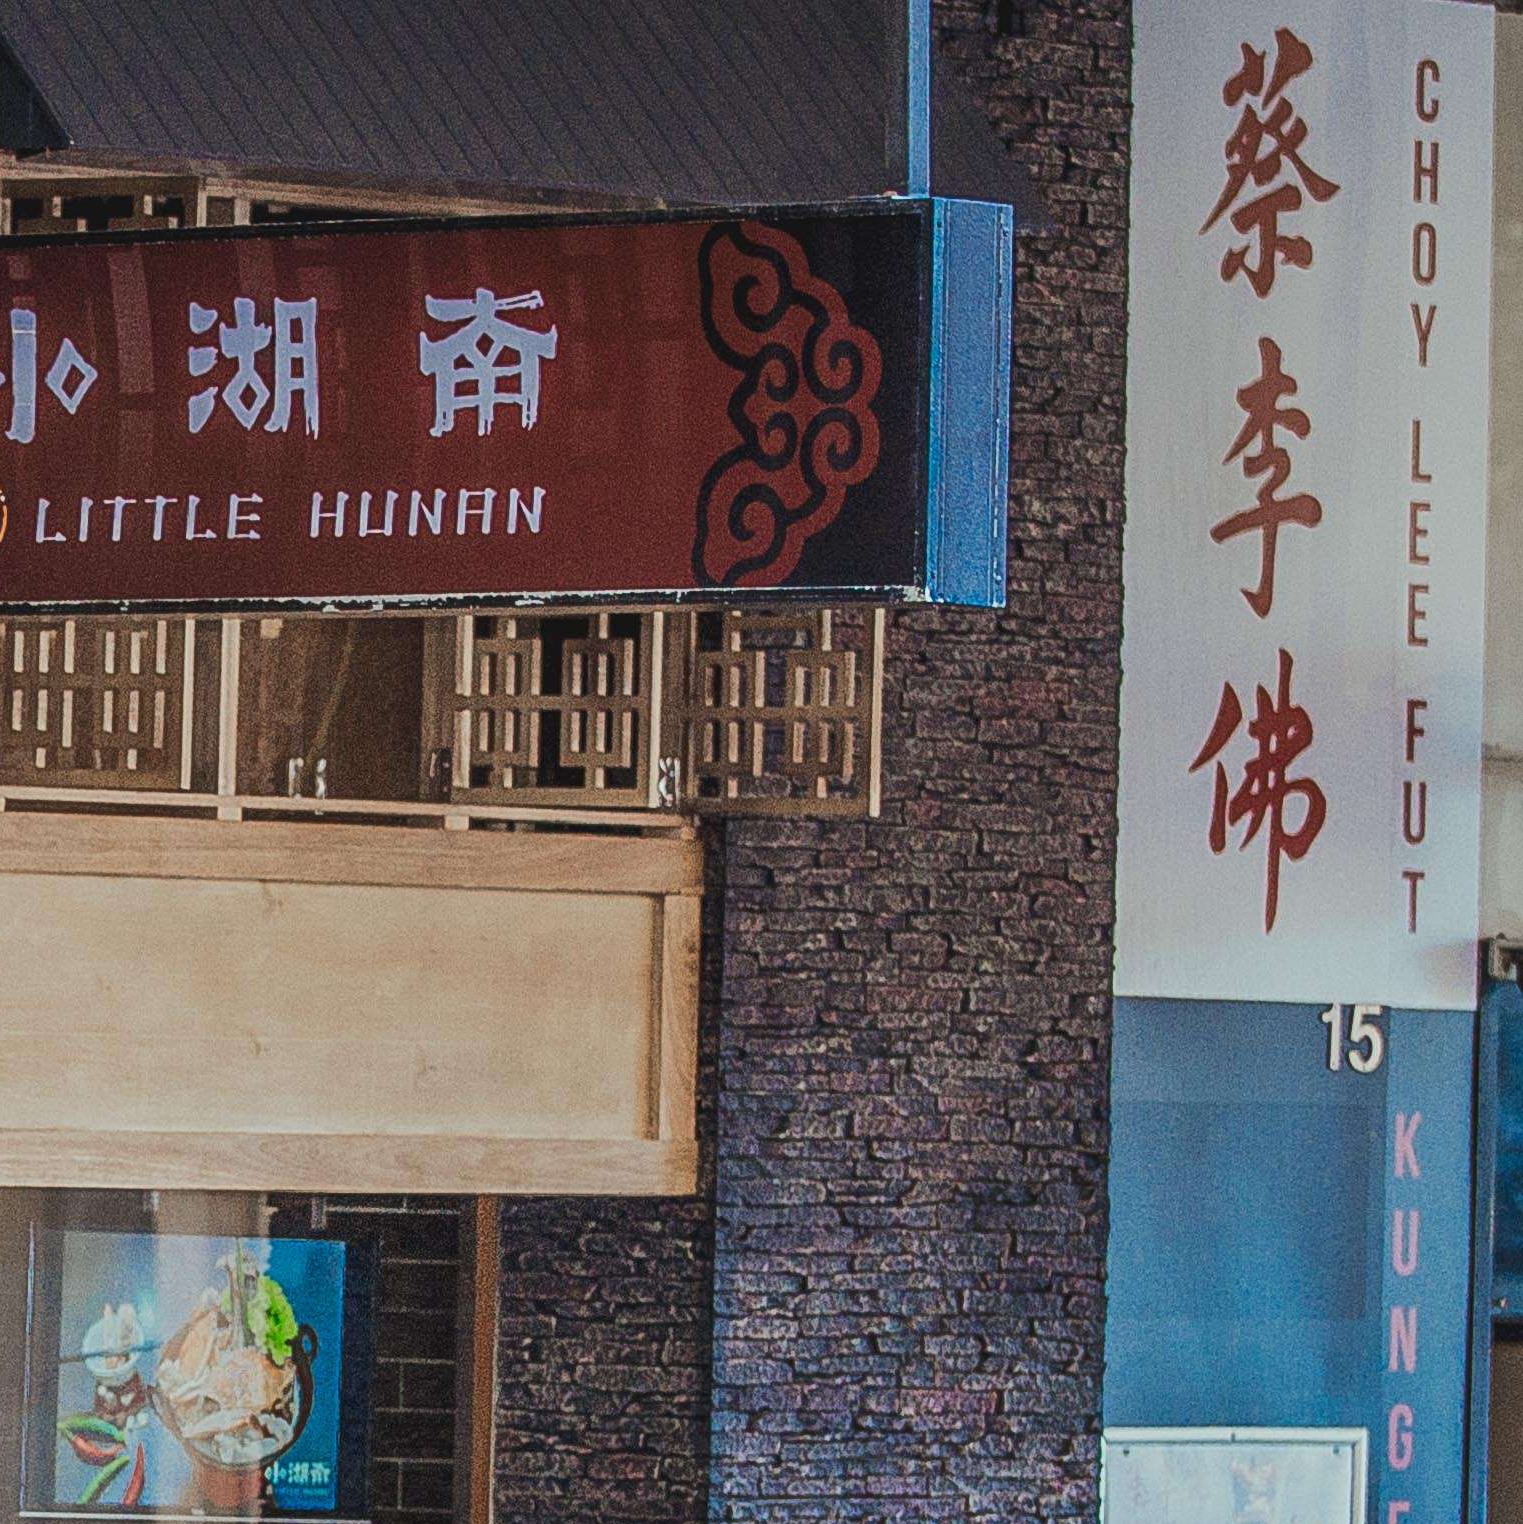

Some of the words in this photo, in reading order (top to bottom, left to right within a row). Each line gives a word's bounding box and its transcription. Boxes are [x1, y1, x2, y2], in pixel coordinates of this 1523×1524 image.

[1410, 58, 1441, 368] CHOY
[35, 492, 264, 543] LITTLE
[310, 486, 547, 540] HUNAN
[1188, 27, 1341, 935] 蔡李佛
[1408, 419, 1433, 649] LEE
[1402, 698, 1428, 935] FUT
[1321, 1003, 1386, 1073] 15
